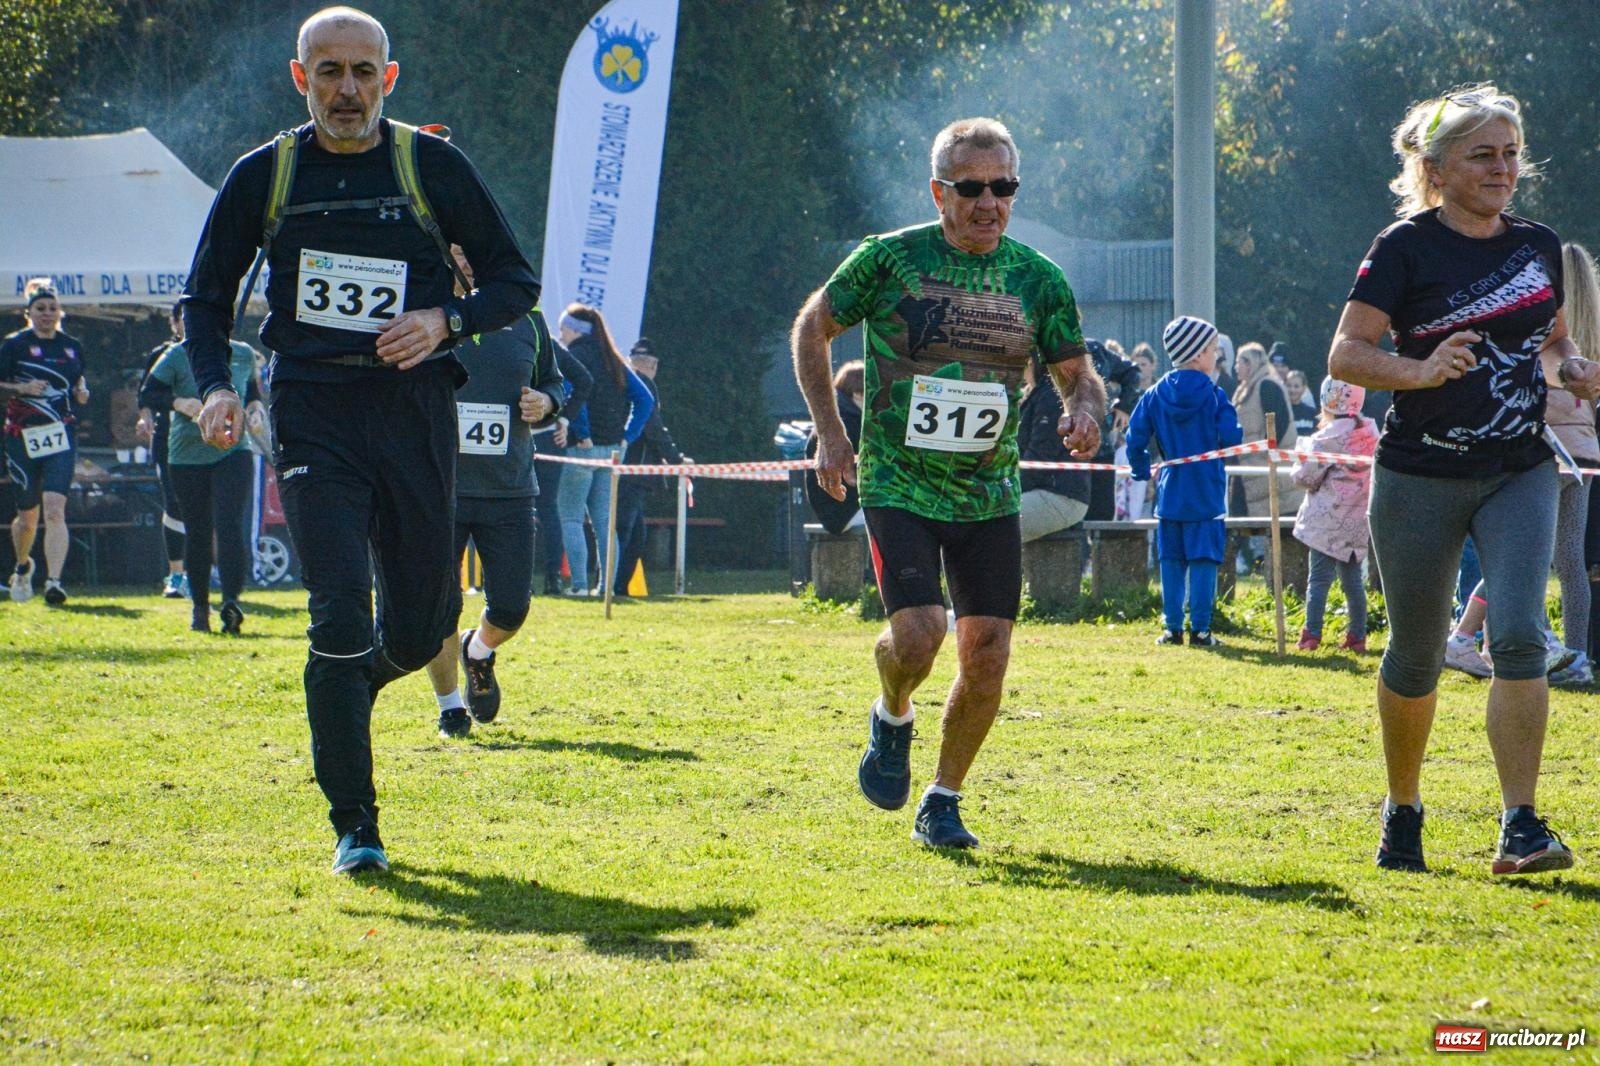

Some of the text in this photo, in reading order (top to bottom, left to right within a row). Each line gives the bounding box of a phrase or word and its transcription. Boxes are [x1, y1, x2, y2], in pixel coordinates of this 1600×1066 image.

[584, 199, 617, 251] AKTYWNI
[338, 263, 403, 276] www.personalbest.pl
[580, 252, 610, 275] DLA
[1447, 243, 1538, 308] KS GRYF KIETRZ
[101, 274, 132, 295] DLA
[304, 278, 398, 319] 332
[913, 402, 1001, 439] 312
[29, 432, 63, 452] 347
[465, 421, 505, 446] 49
